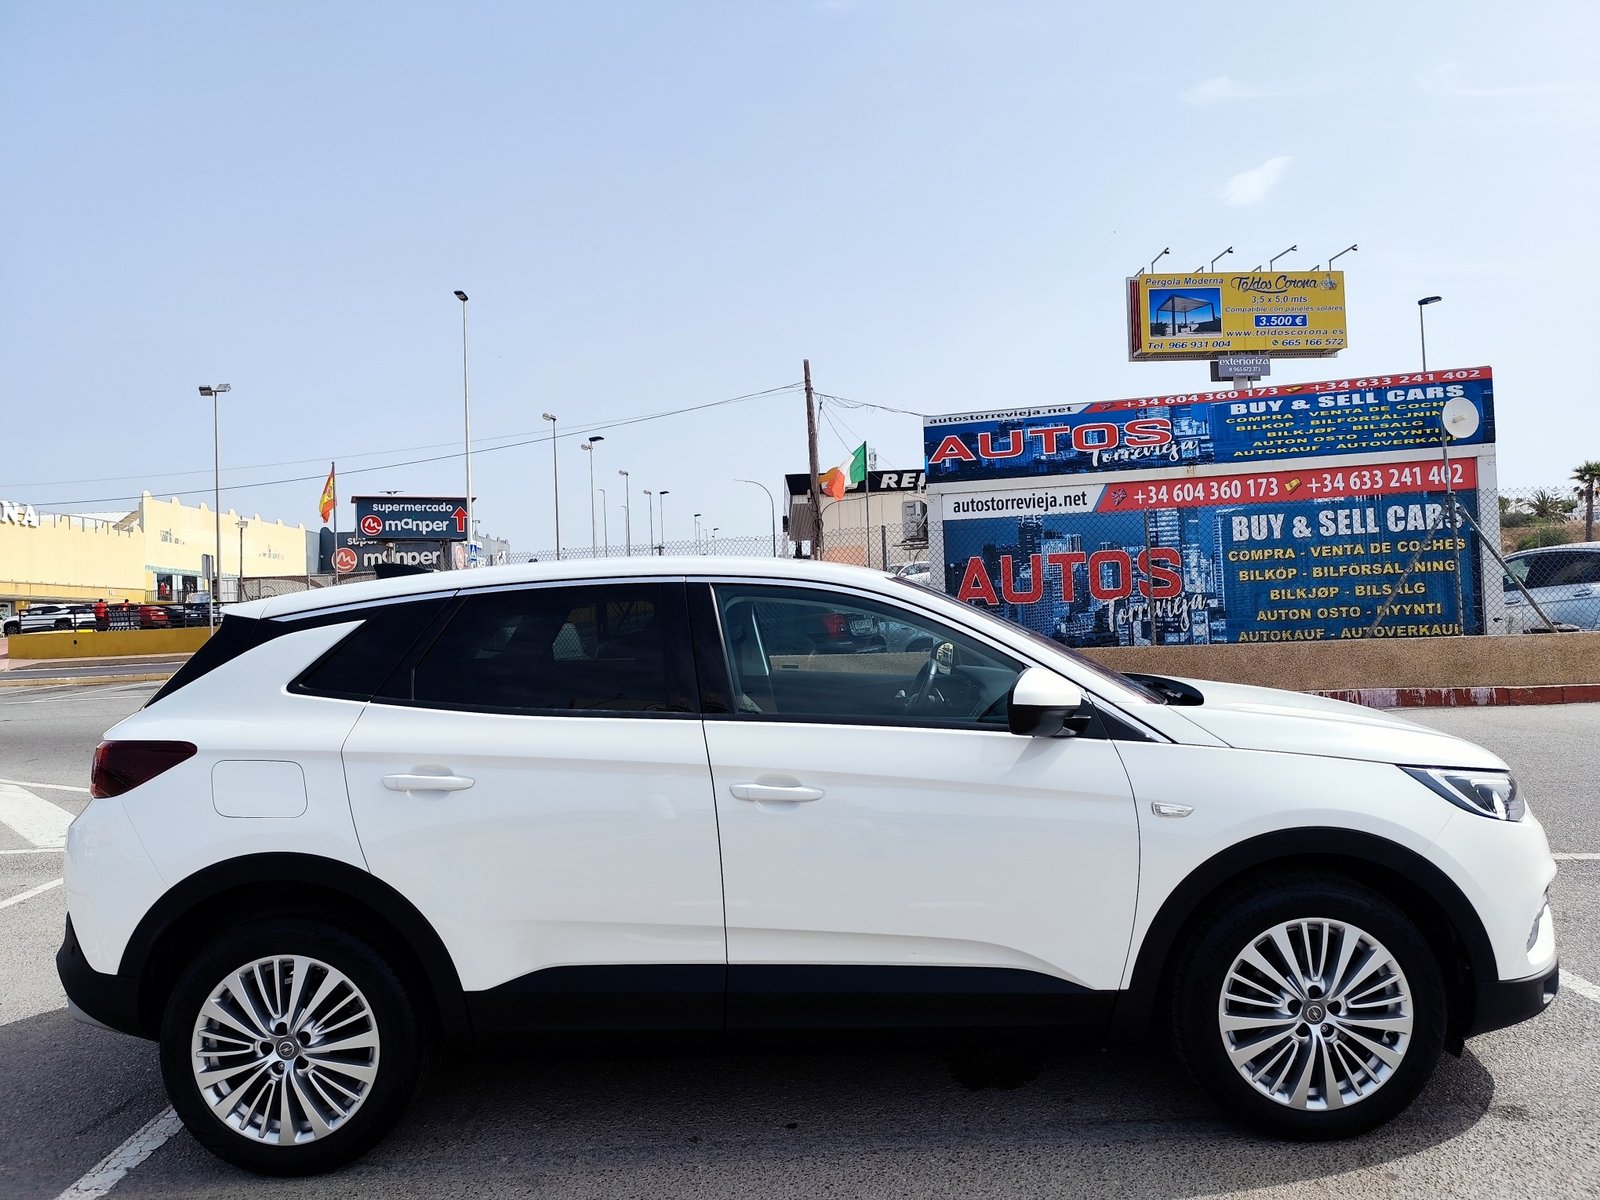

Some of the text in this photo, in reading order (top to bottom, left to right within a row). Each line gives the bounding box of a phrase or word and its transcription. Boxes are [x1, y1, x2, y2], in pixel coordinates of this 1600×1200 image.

[1145, 277, 1224, 287] Pergola Moderna
[1230, 274, 1318, 292] Toldos Corona
[1251, 295, 1265, 304] 3,5
[1275, 295, 1289, 303] 5,0
[1259, 316, 1304, 326] 3.500 €
[1226, 328, 1344, 337] www.toldoscorona.es
[1168, 341, 1188, 349] 966
[1190, 341, 1209, 349] 931
[1211, 340, 1231, 348] 004
[1281, 338, 1344, 347] 665 166 572
[1219, 356, 1269, 366] exterioriza
[929, 369, 1480, 424] autostorrevieja.net +34 604 360 173 +34 633 241 402
[1230, 384, 1464, 416] BUY & SELL CARS
[1225, 413, 1293, 424] COMPRA
[1309, 407, 1363, 417] VENTA
[1352, 420, 1424, 431] BILSALG
[928, 418, 1172, 464] AUTOS
[1252, 438, 1308, 447] AUTON
[1313, 433, 1358, 442] OSTO
[1373, 428, 1440, 438] MYYNTI
[1088, 440, 1198, 467] Torrevieja
[1233, 445, 1320, 457] AUTOKAUF
[953, 463, 1464, 513] autostorrevieja.net +34 604 360 173 +34 633 241 402
[372, 502, 453, 514] supermercado
[385, 517, 449, 535] manper
[1231, 513, 1285, 542] BUY
[1292, 515, 1312, 539] &
[1318, 507, 1380, 537] SELL
[1228, 548, 1296, 562] COMPRA
[1310, 544, 1365, 558] VENTA
[1370, 542, 1391, 554] DE
[957, 547, 1183, 605] AUTOS
[1239, 566, 1297, 581] BILKÖP
[1312, 560, 1456, 579] BILFÖRSÄLNING
[1270, 586, 1340, 600] BILKJØP
[1256, 608, 1312, 621] AUTON
[1317, 606, 1361, 619] OSTO
[1238, 628, 1325, 642] AUTOKAUF
